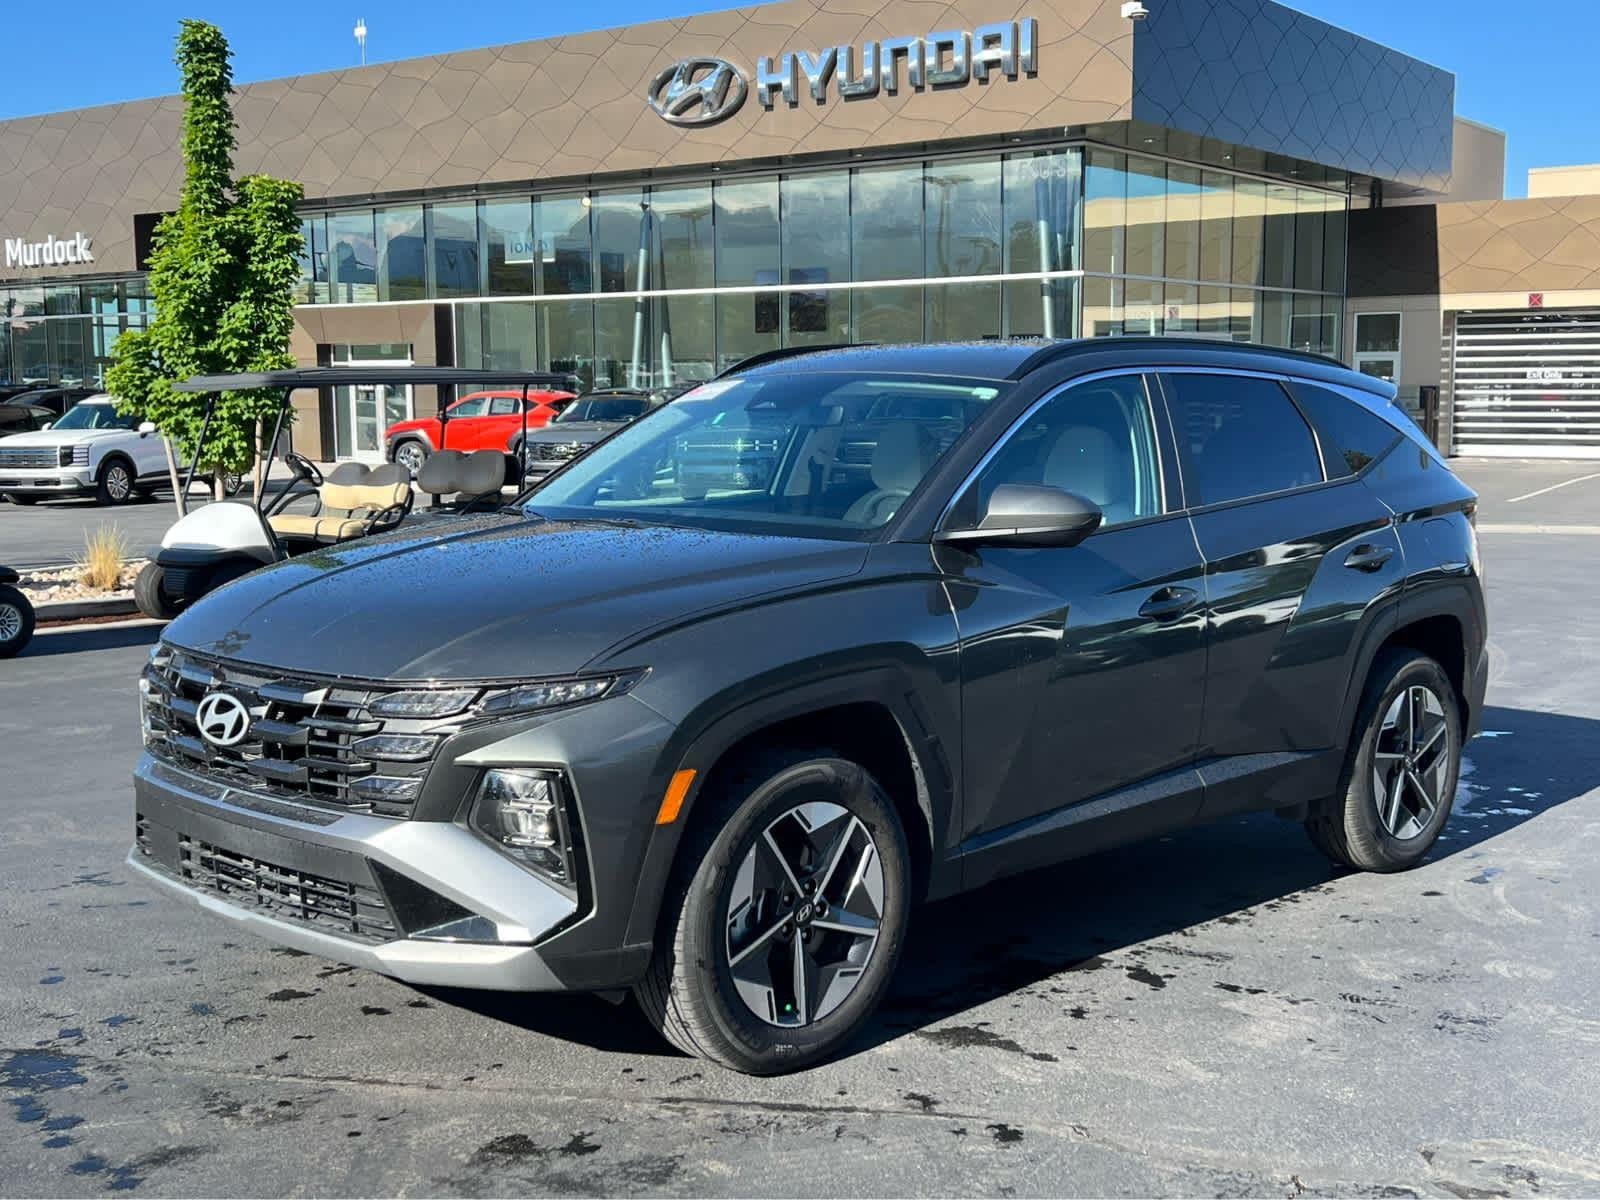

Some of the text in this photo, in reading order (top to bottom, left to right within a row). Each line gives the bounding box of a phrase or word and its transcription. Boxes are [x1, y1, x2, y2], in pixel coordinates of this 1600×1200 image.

[757, 17, 1038, 110] HYUNDAI
[5, 232, 94, 267] Murdock
[510, 240, 549, 254] ION
